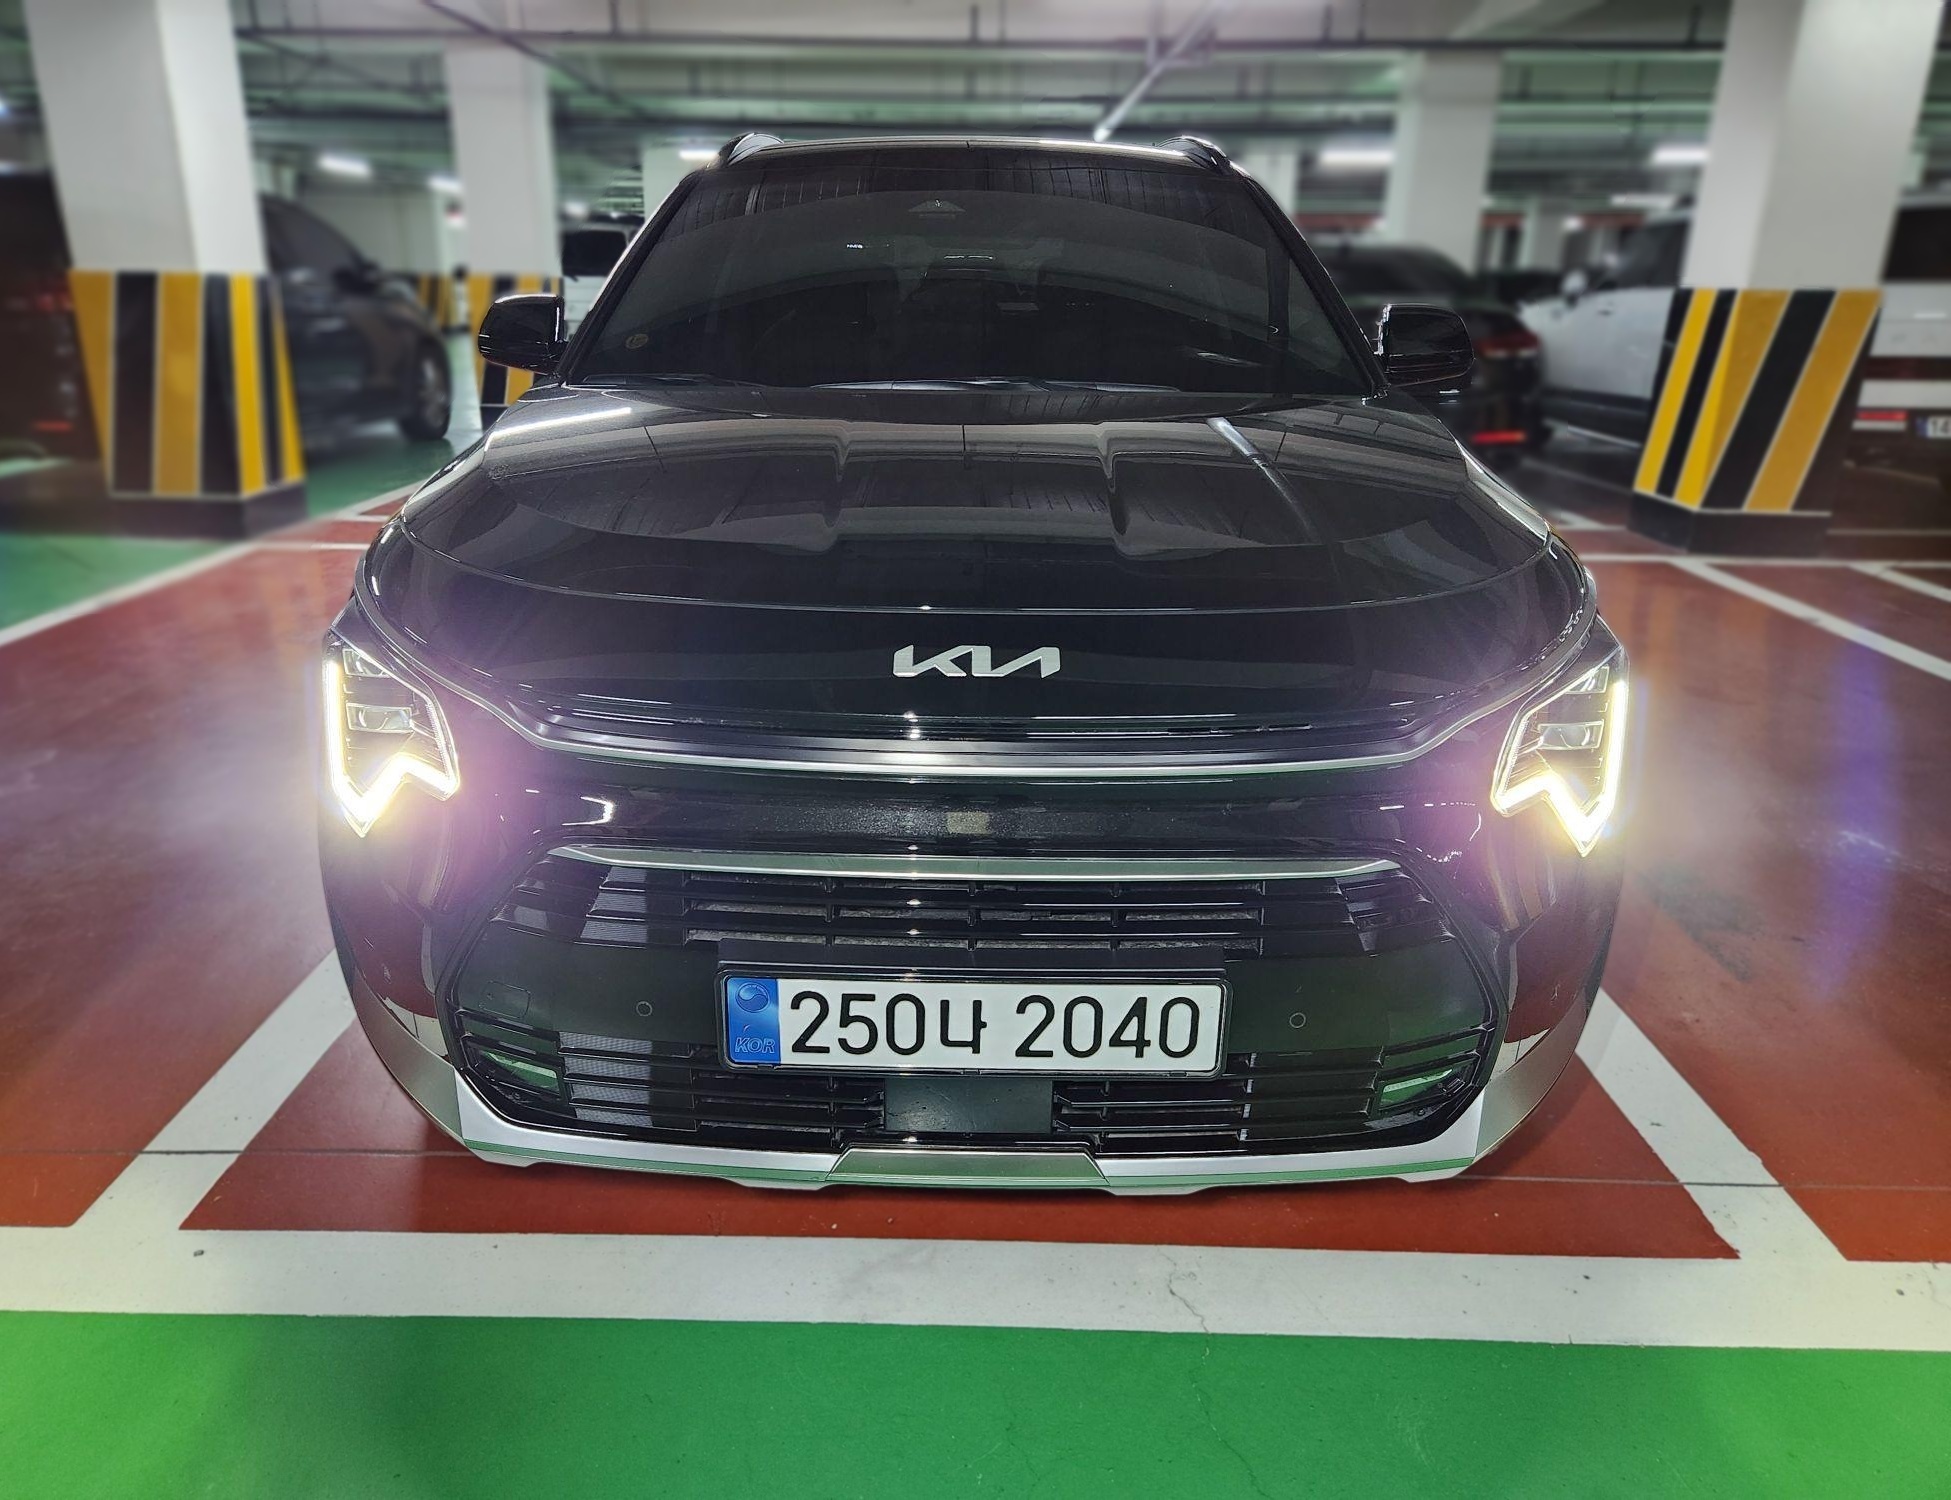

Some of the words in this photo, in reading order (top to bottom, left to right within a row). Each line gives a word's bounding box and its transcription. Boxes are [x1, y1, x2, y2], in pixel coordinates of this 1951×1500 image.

[892, 644, 1061, 679] KIA
[789, 990, 989, 1056] 250나
[1015, 994, 1201, 1059] 2040
[734, 1037, 776, 1054] KOR
